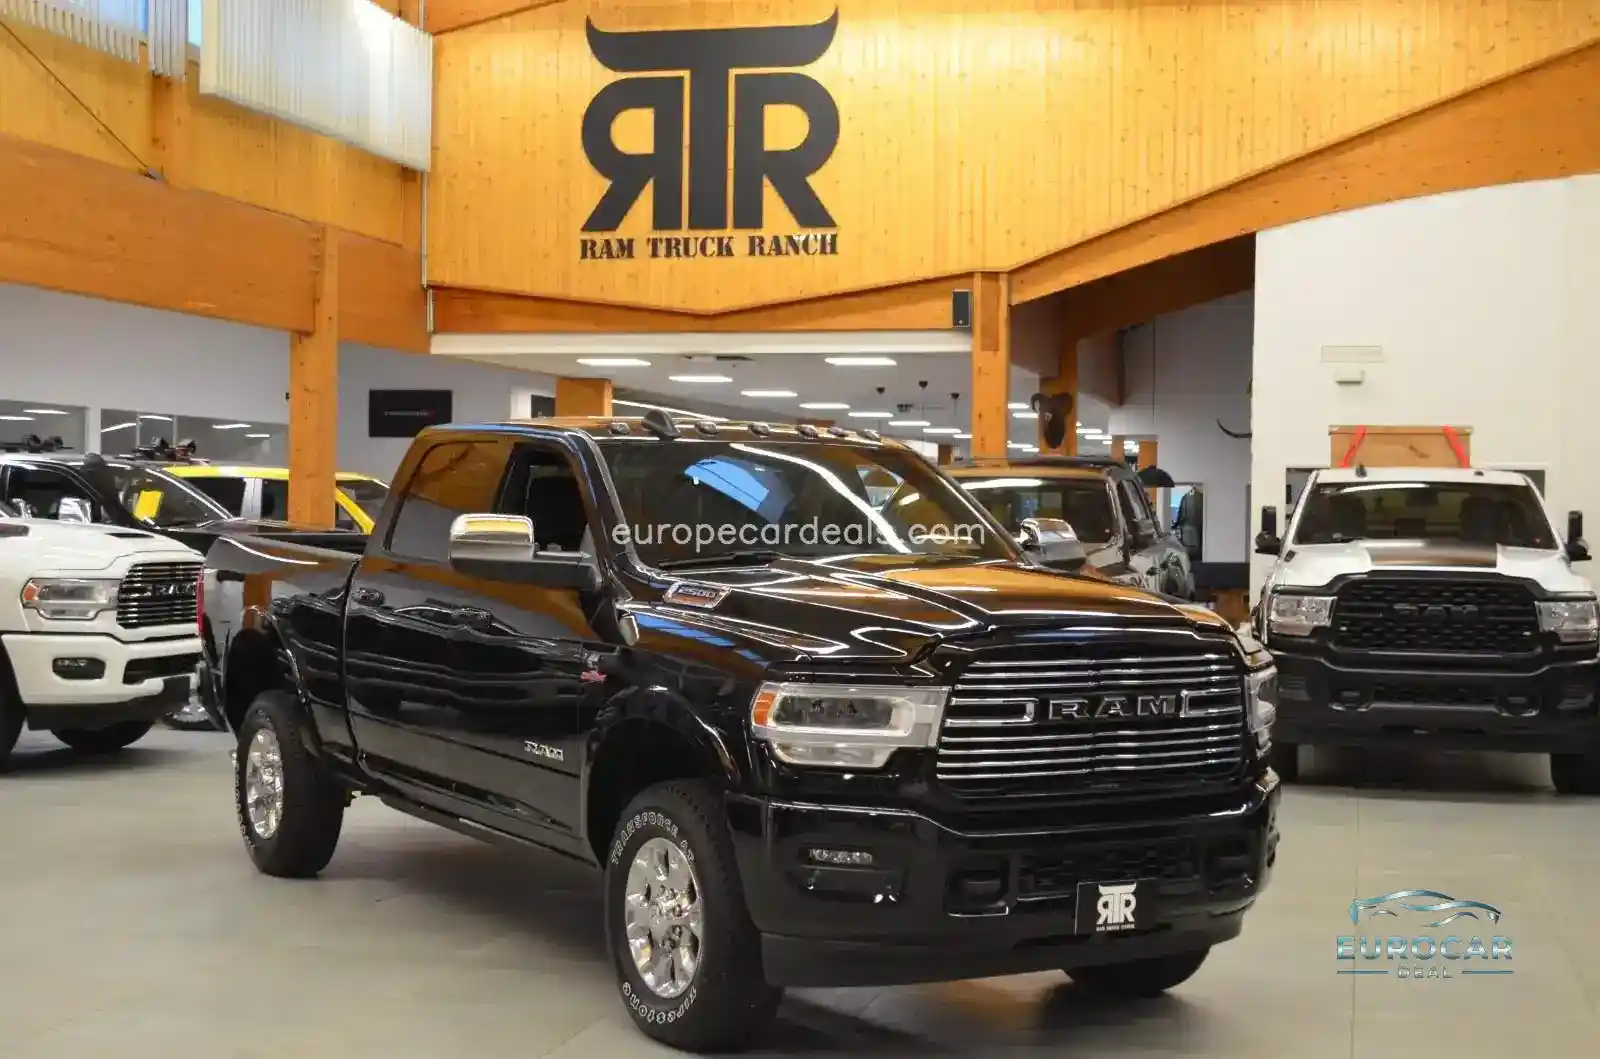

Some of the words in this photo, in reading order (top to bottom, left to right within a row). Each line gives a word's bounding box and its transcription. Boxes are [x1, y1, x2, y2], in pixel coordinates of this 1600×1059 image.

[580, 238, 634, 260] RAM
[647, 236, 735, 259] TRUCK
[748, 233, 839, 257] RANCH
[1048, 694, 1177, 720] RAM
